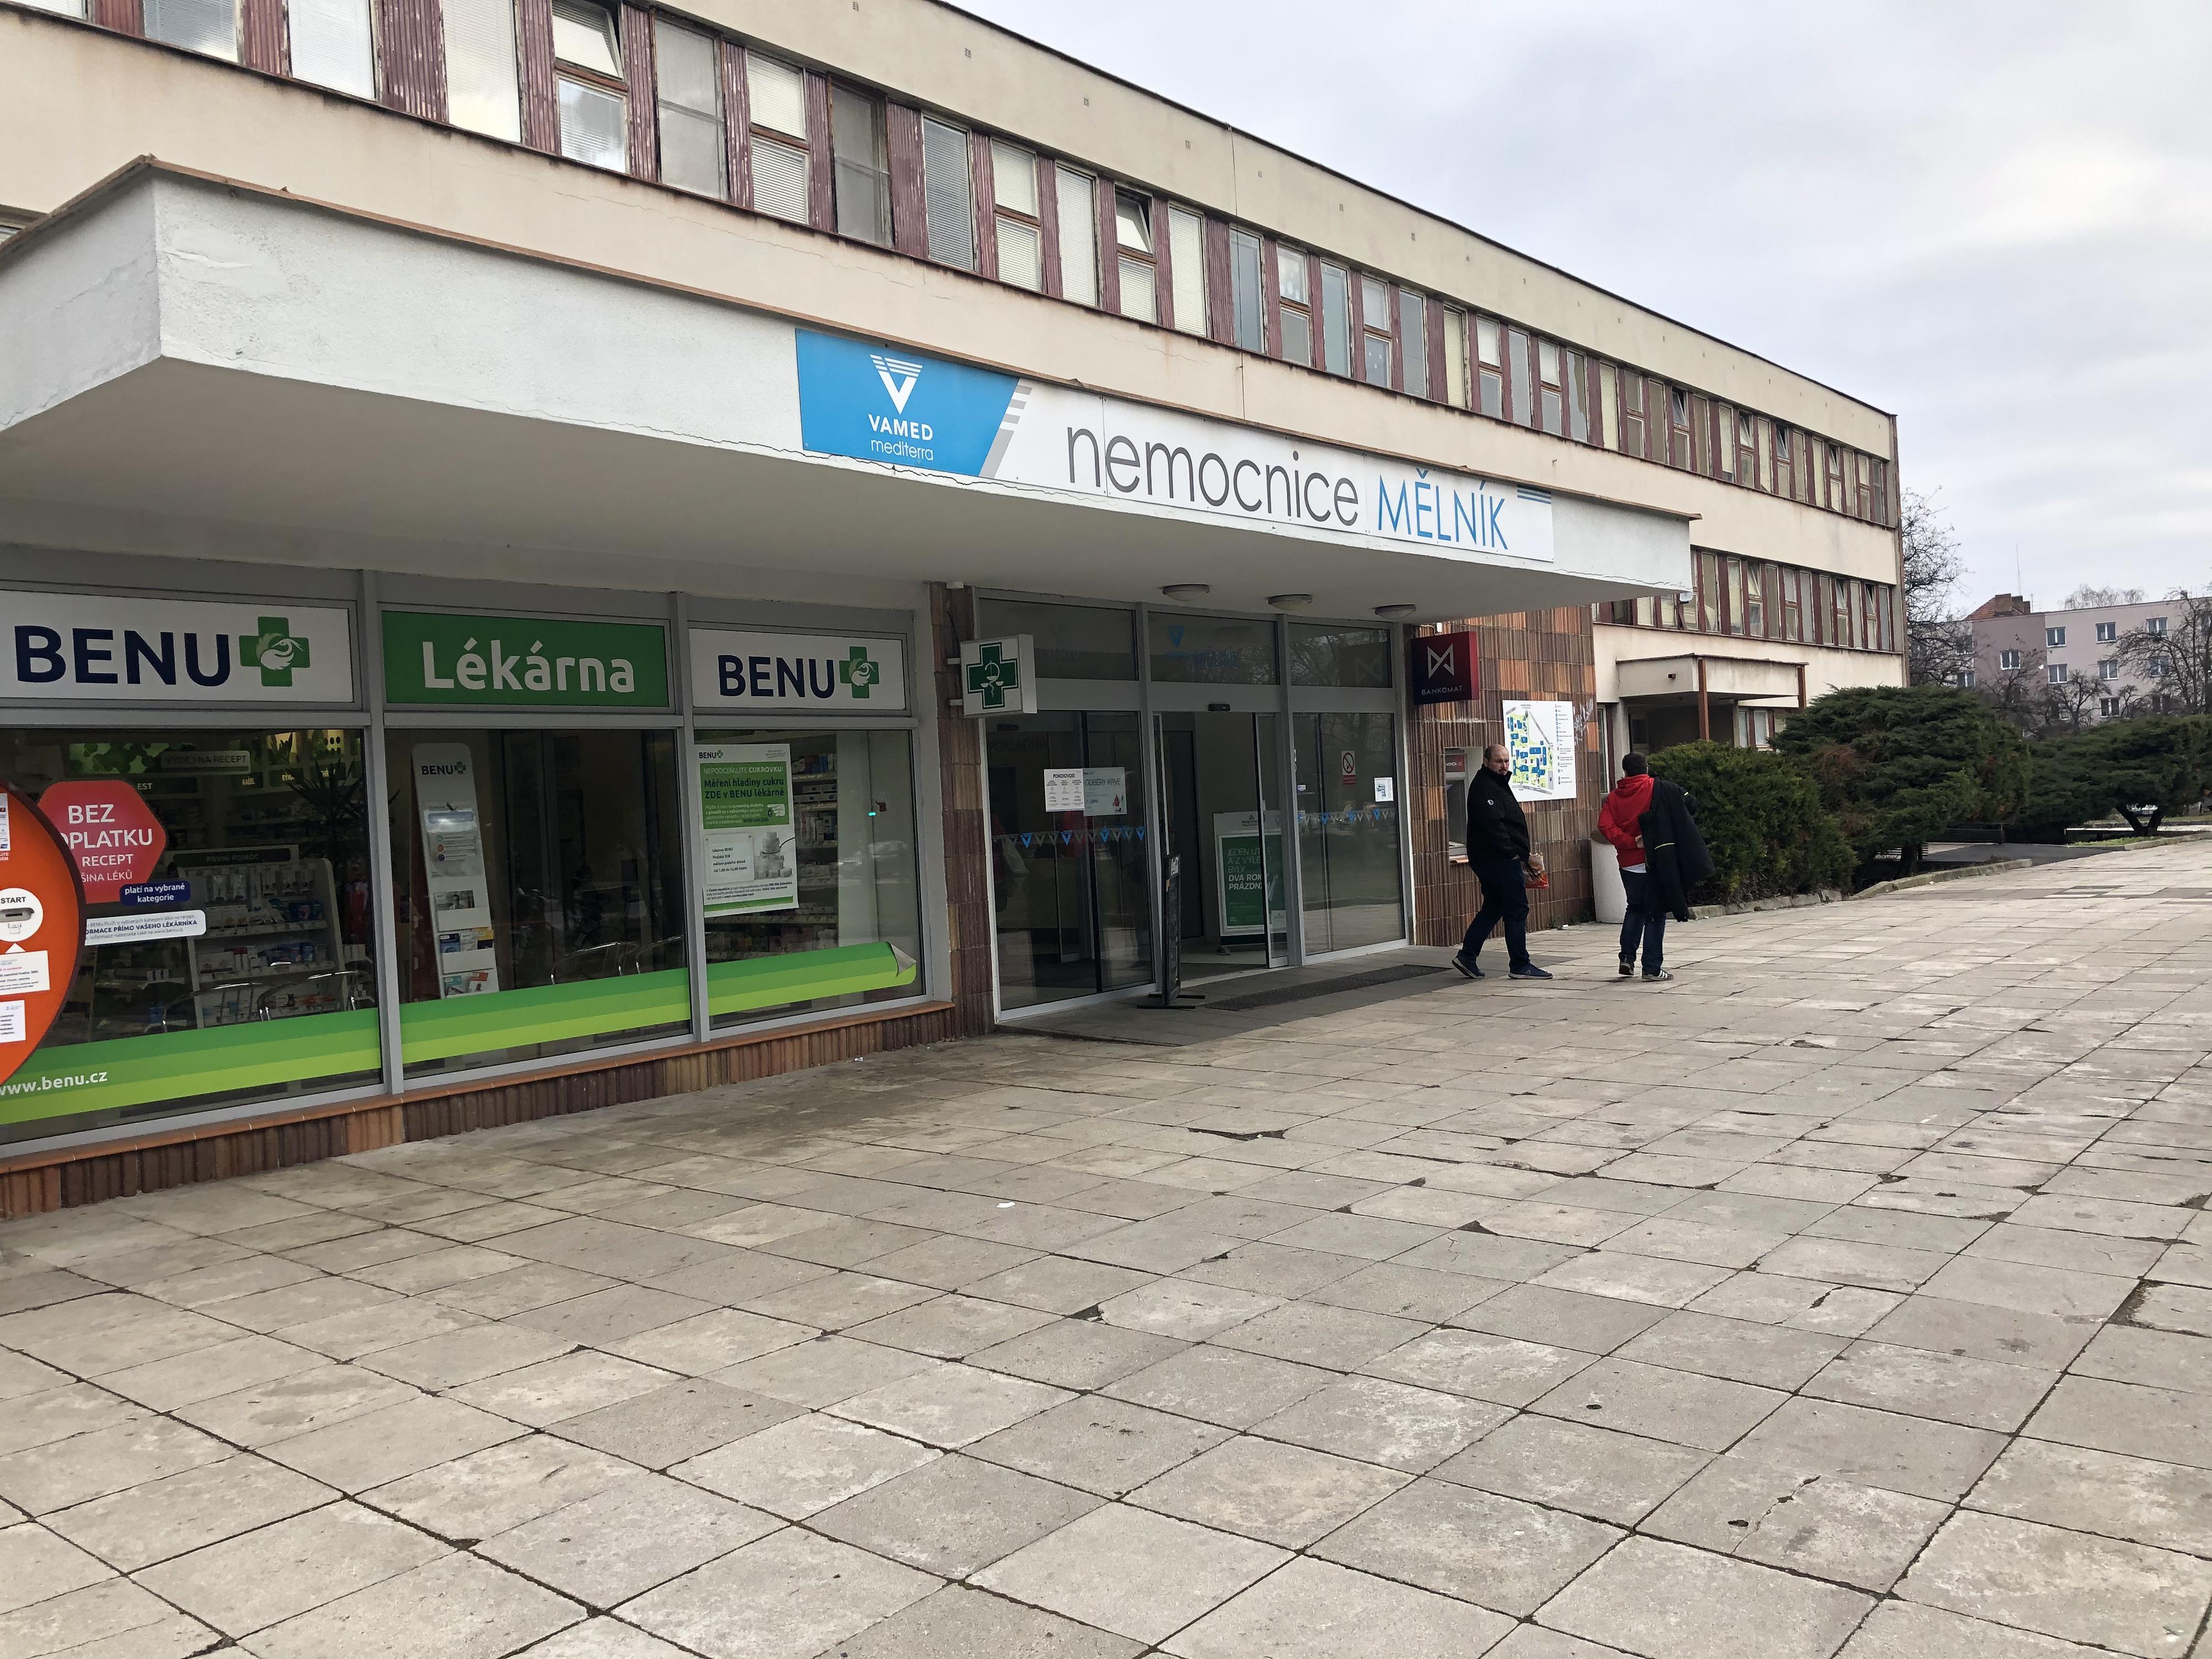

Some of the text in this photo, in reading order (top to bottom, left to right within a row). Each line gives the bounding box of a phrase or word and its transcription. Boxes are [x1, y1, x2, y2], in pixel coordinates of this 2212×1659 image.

[868, 414, 933, 441] VAMED
[870, 437, 934, 461] mediterra
[1066, 426, 1509, 550] nemocnice MĚLNÍK
[14, 625, 231, 687] BENU
[422, 637, 635, 693] Lékárna
[718, 654, 836, 699] BENU
[1421, 685, 1463, 696] BANKOMAT
[421, 765, 453, 775] BENU
[703, 766, 747, 774] NEPODCEŇUJTE
[704, 779, 731, 788] Měření
[733, 778, 760, 787] hladiny
[705, 791, 721, 799] ZDE
[730, 789, 752, 798] BENU
[754, 787, 784, 797] lékárně
[68, 804, 115, 824] BEZ
[1227, 848, 1249, 857] JEDEN
[82, 854, 134, 867] RECEPT
[107, 869, 132, 881] LÉKŮ
[125, 885, 142, 895] platí
[155, 883, 185, 891] vybrané
[138, 893, 174, 904] kategorie
[163, 920, 197, 928] LÉKÁRNÍKA
